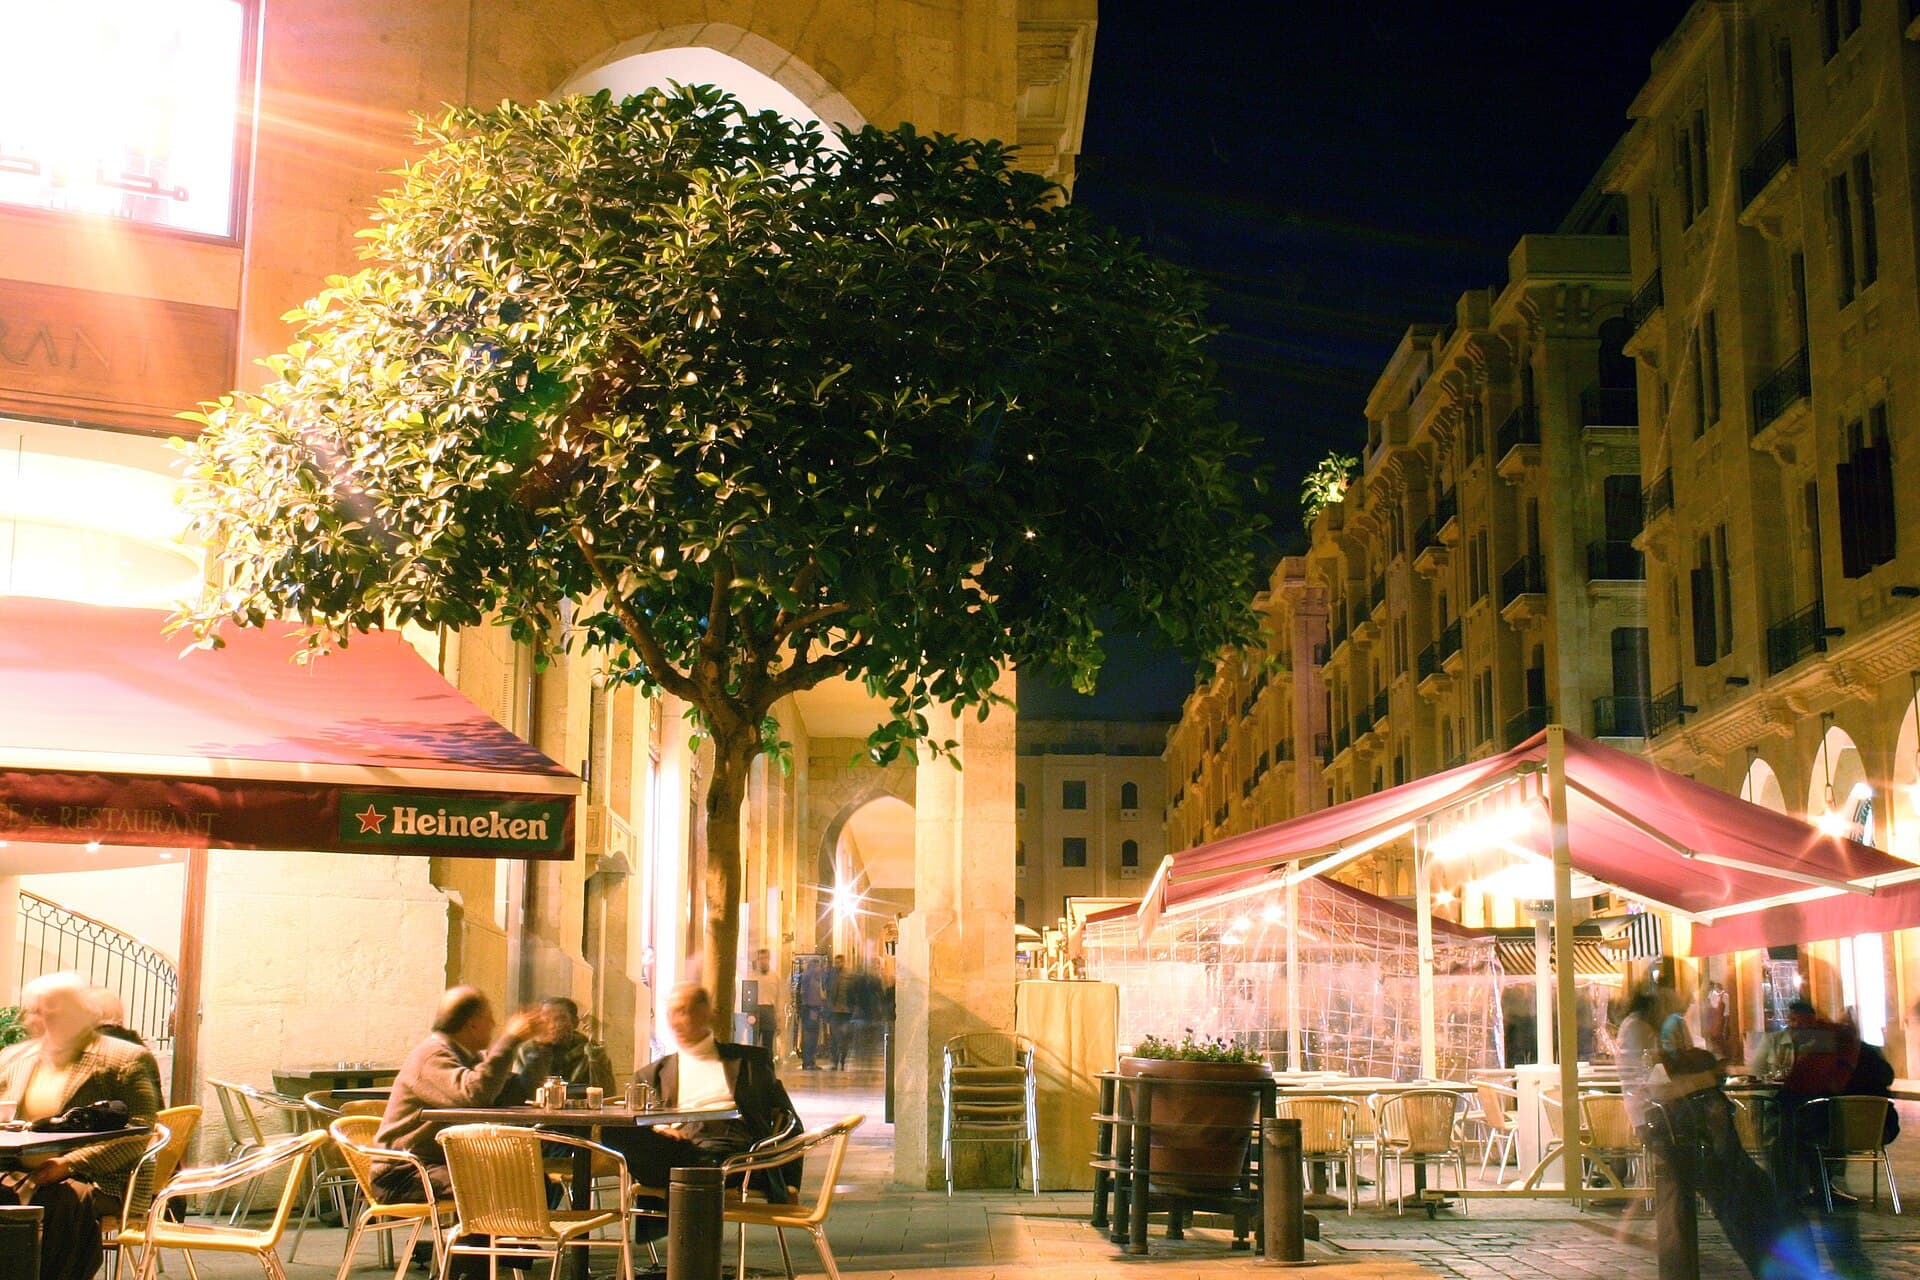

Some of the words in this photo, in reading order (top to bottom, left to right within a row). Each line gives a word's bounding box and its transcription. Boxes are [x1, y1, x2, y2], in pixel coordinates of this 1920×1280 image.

[29, 807, 50, 828] &
[59, 806, 219, 836] RESTAURANT
[391, 806, 549, 840] Heineken
